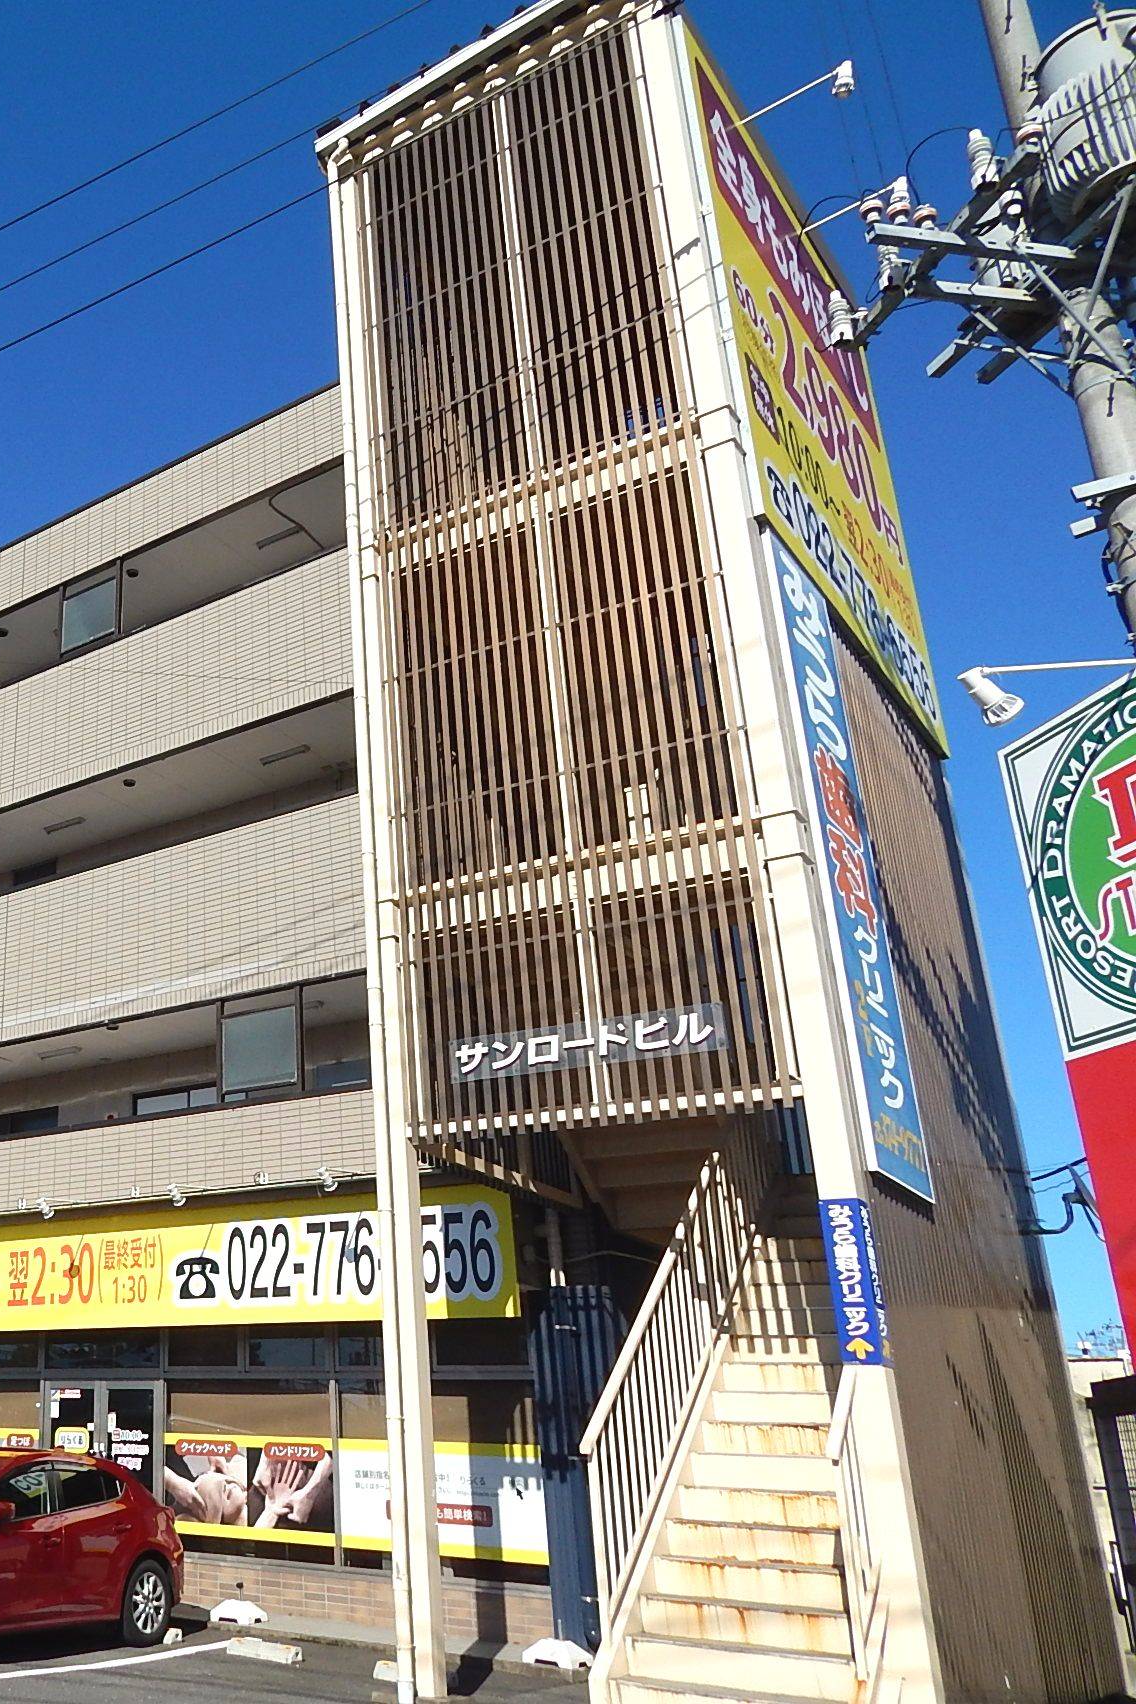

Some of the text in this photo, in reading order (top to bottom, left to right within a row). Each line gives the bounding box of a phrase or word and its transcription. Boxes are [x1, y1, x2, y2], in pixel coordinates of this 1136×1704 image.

[709, 109, 869, 412] 全身もみほし
[1051, 895, 1136, 992] ESORT
[455, 1012, 714, 1074] サンロードビル
[180, 1441, 232, 1453] クイックヘッド
[269, 1445, 319, 1458] ハンドリフレ
